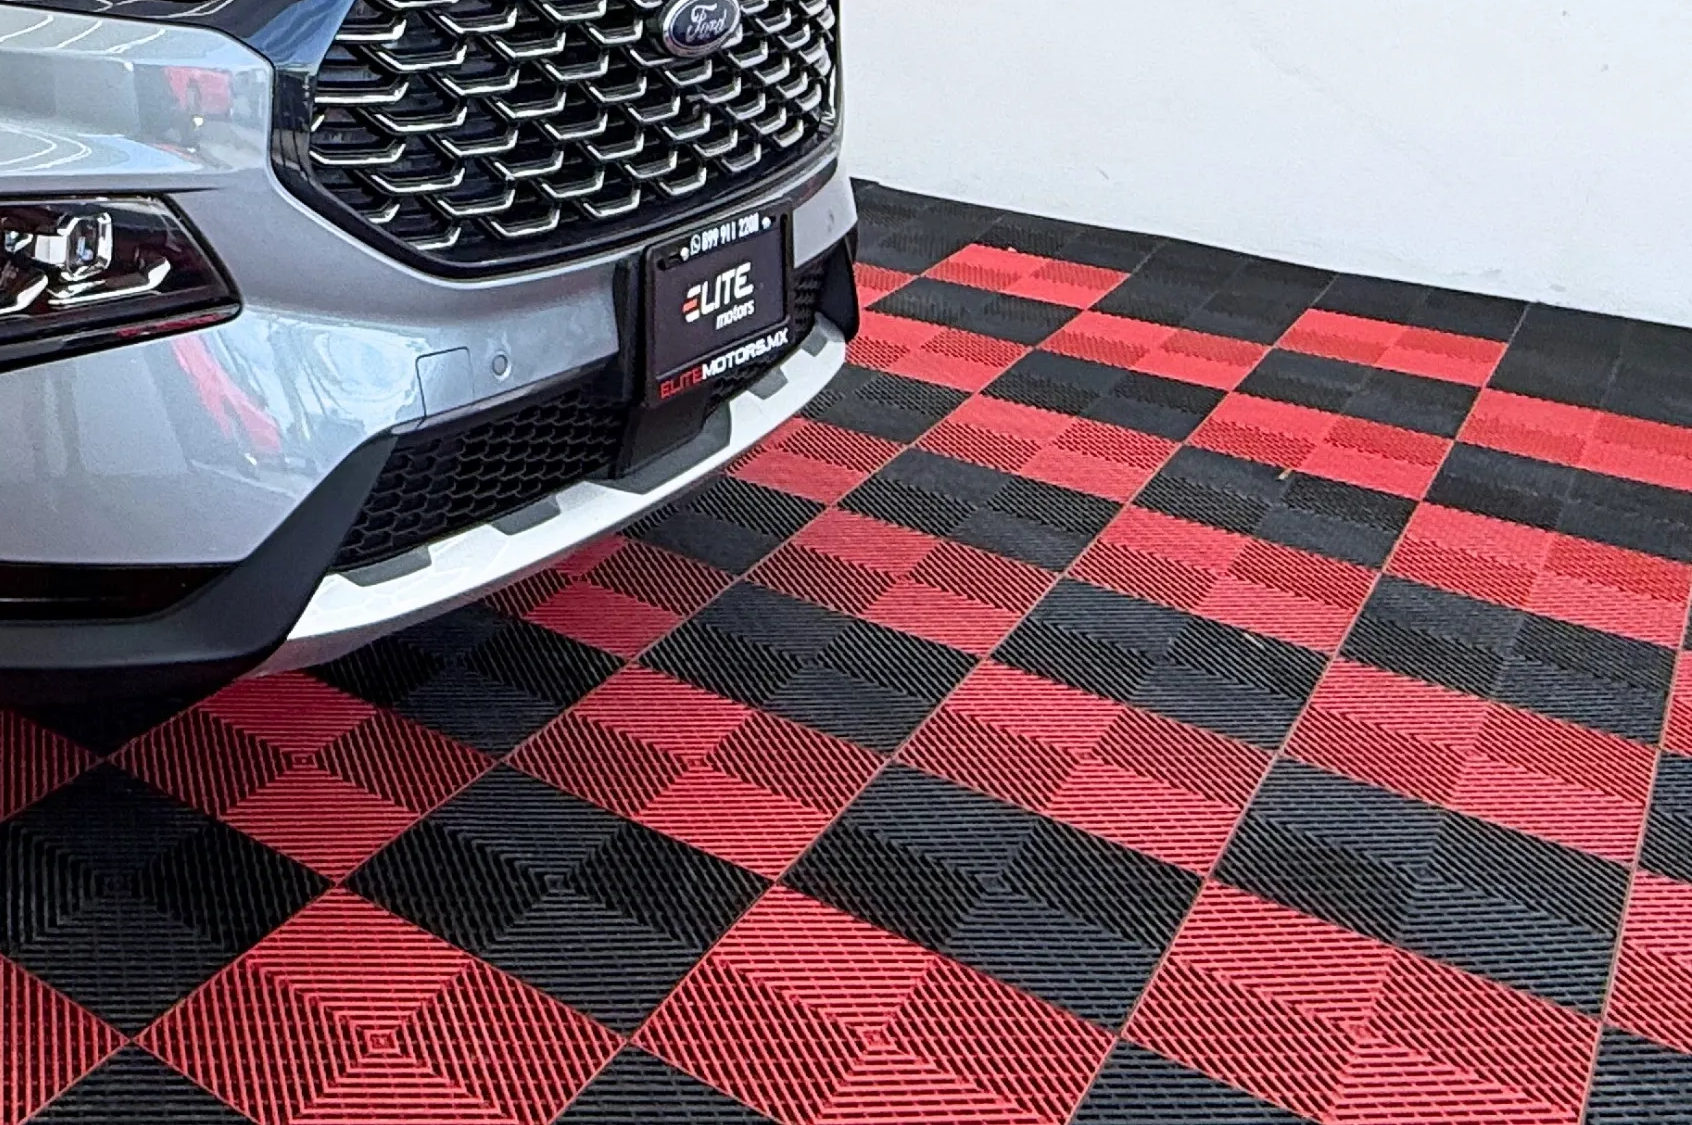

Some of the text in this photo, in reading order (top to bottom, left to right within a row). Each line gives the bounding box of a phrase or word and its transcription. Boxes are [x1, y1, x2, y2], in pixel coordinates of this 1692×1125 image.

[686, 2, 727, 42] Ford
[720, 220, 736, 245] 911
[682, 261, 755, 323] ELITE
[716, 299, 755, 330] motors
